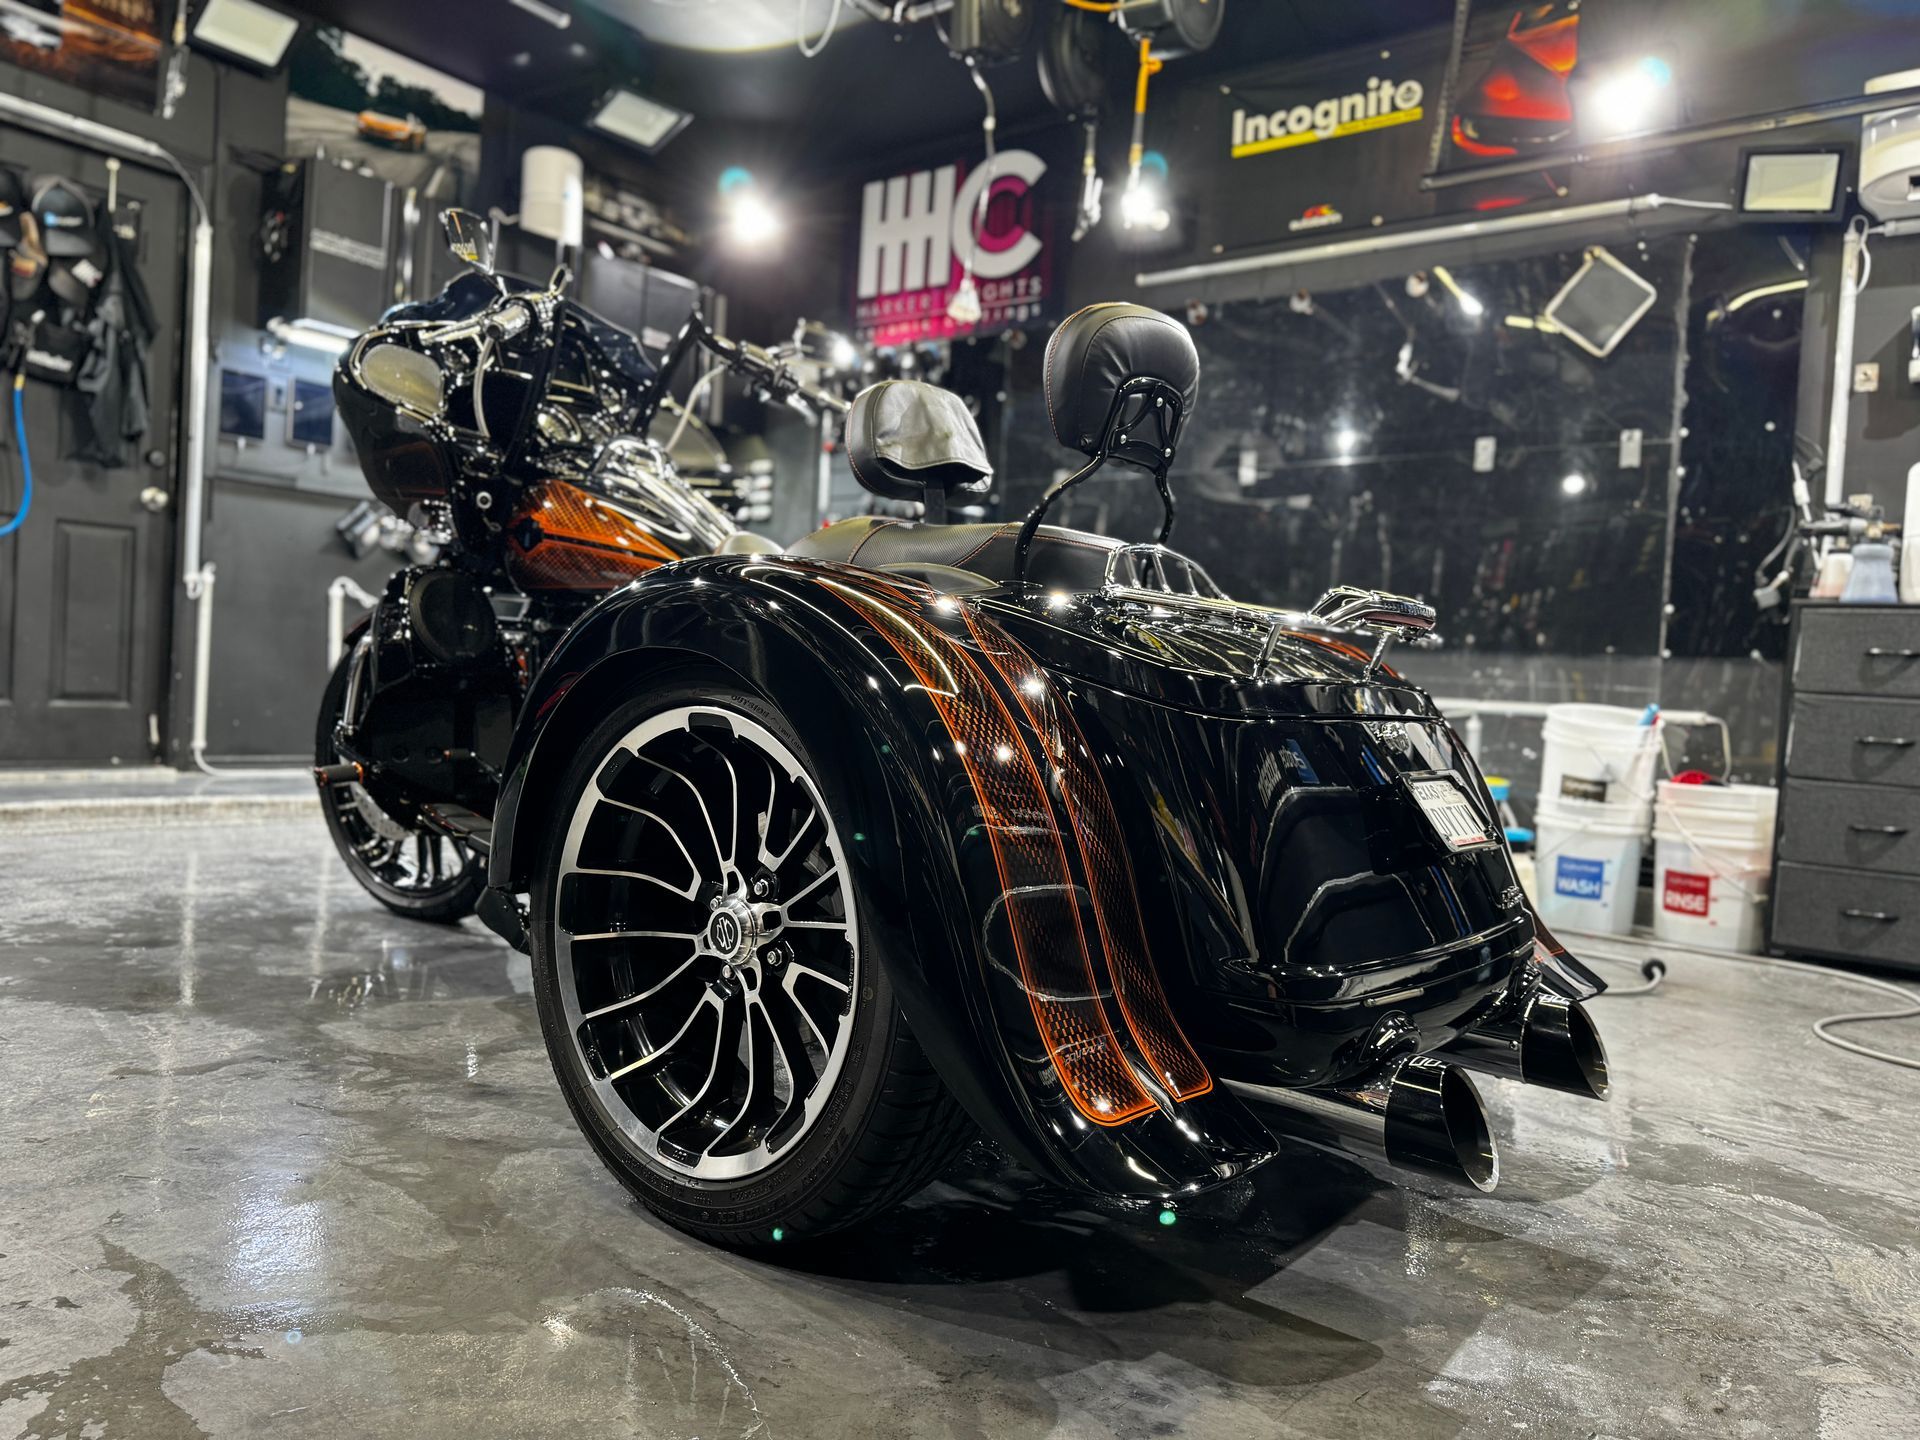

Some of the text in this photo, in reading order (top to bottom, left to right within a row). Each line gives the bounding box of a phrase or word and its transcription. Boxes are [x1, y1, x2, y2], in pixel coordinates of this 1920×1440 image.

[1232, 76, 1424, 146] Incognito
[1414, 784, 1441, 801] EXAS
[1556, 876, 1601, 896] WASH
[1665, 889, 1707, 912] RINSE
